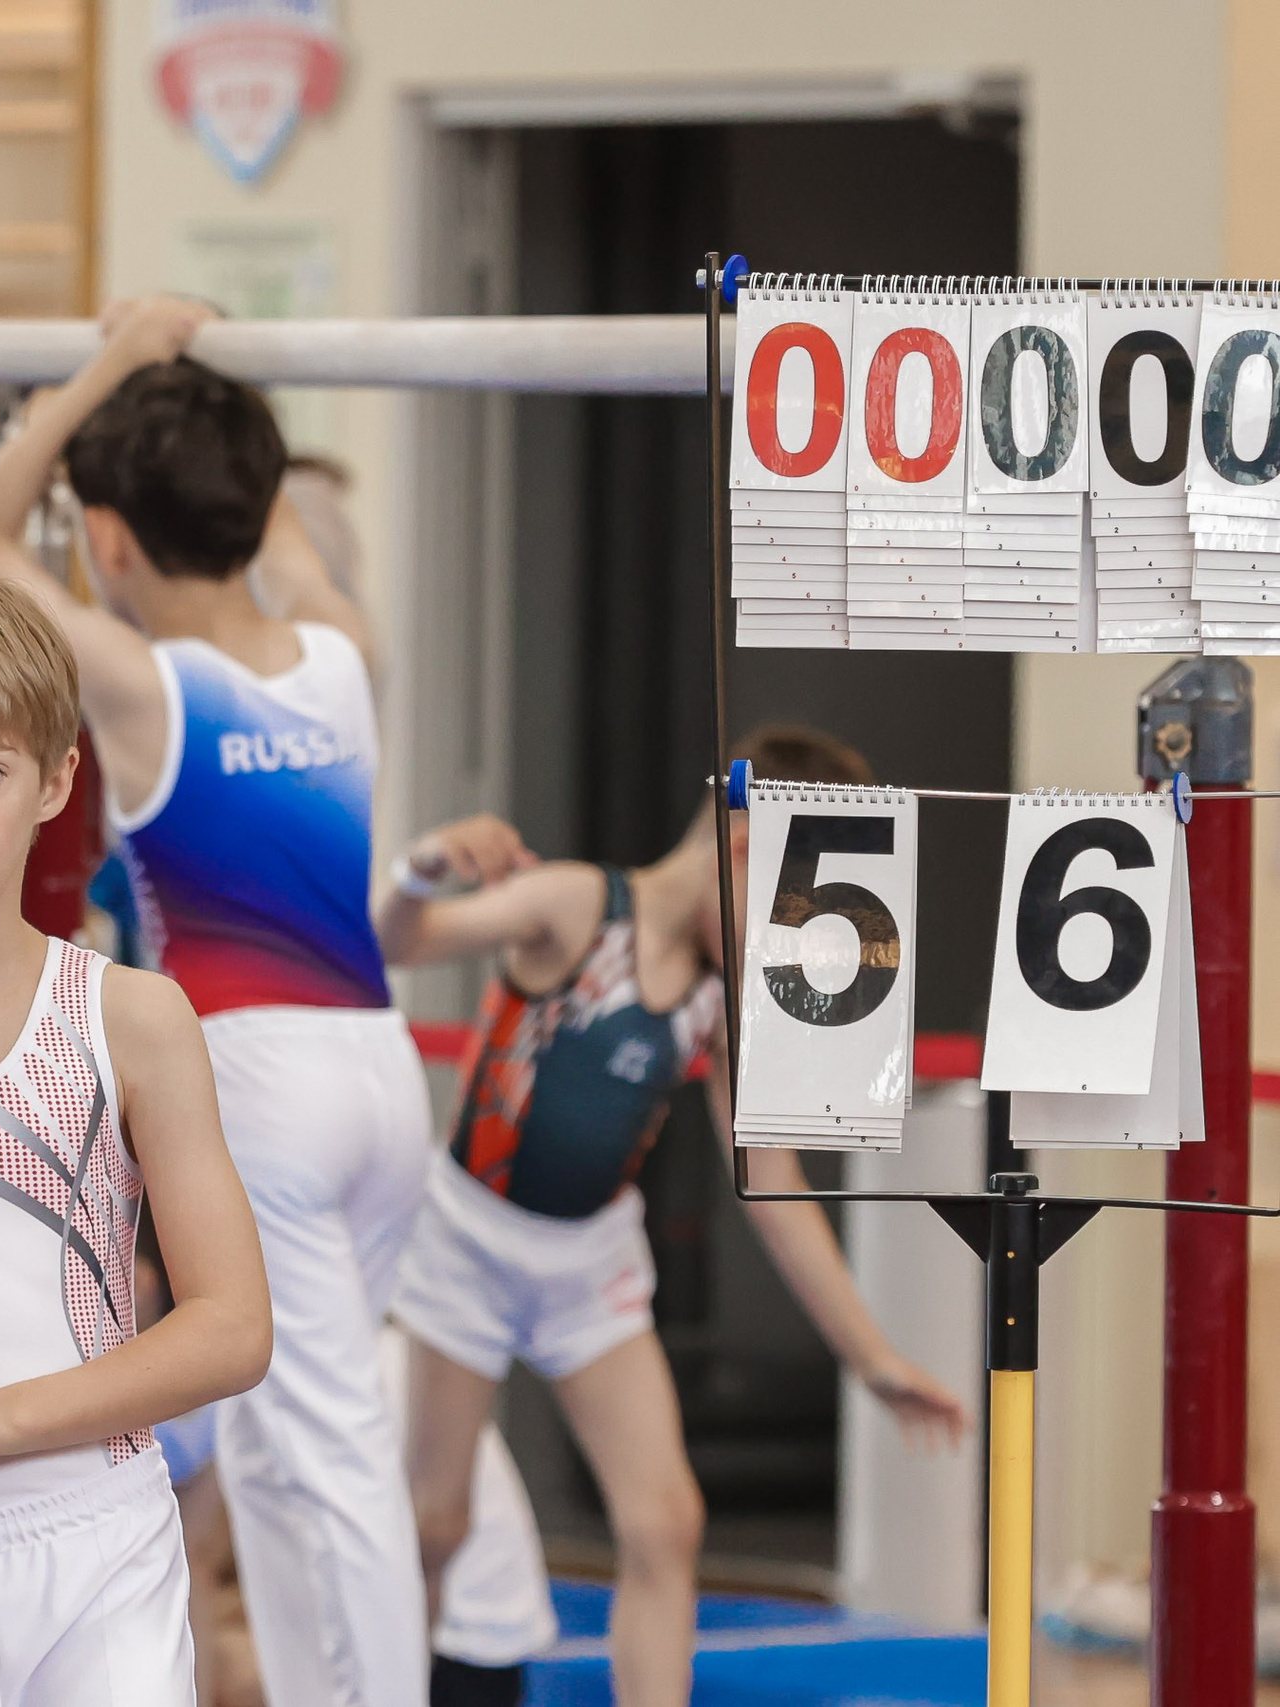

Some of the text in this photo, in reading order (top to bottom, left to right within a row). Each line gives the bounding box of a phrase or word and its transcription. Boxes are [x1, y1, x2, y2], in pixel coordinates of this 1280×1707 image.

[747, 322, 1280, 486] 0 0 0 0 0
[219, 727, 366, 775] RUSS
[763, 815, 1155, 1026] 5 6
